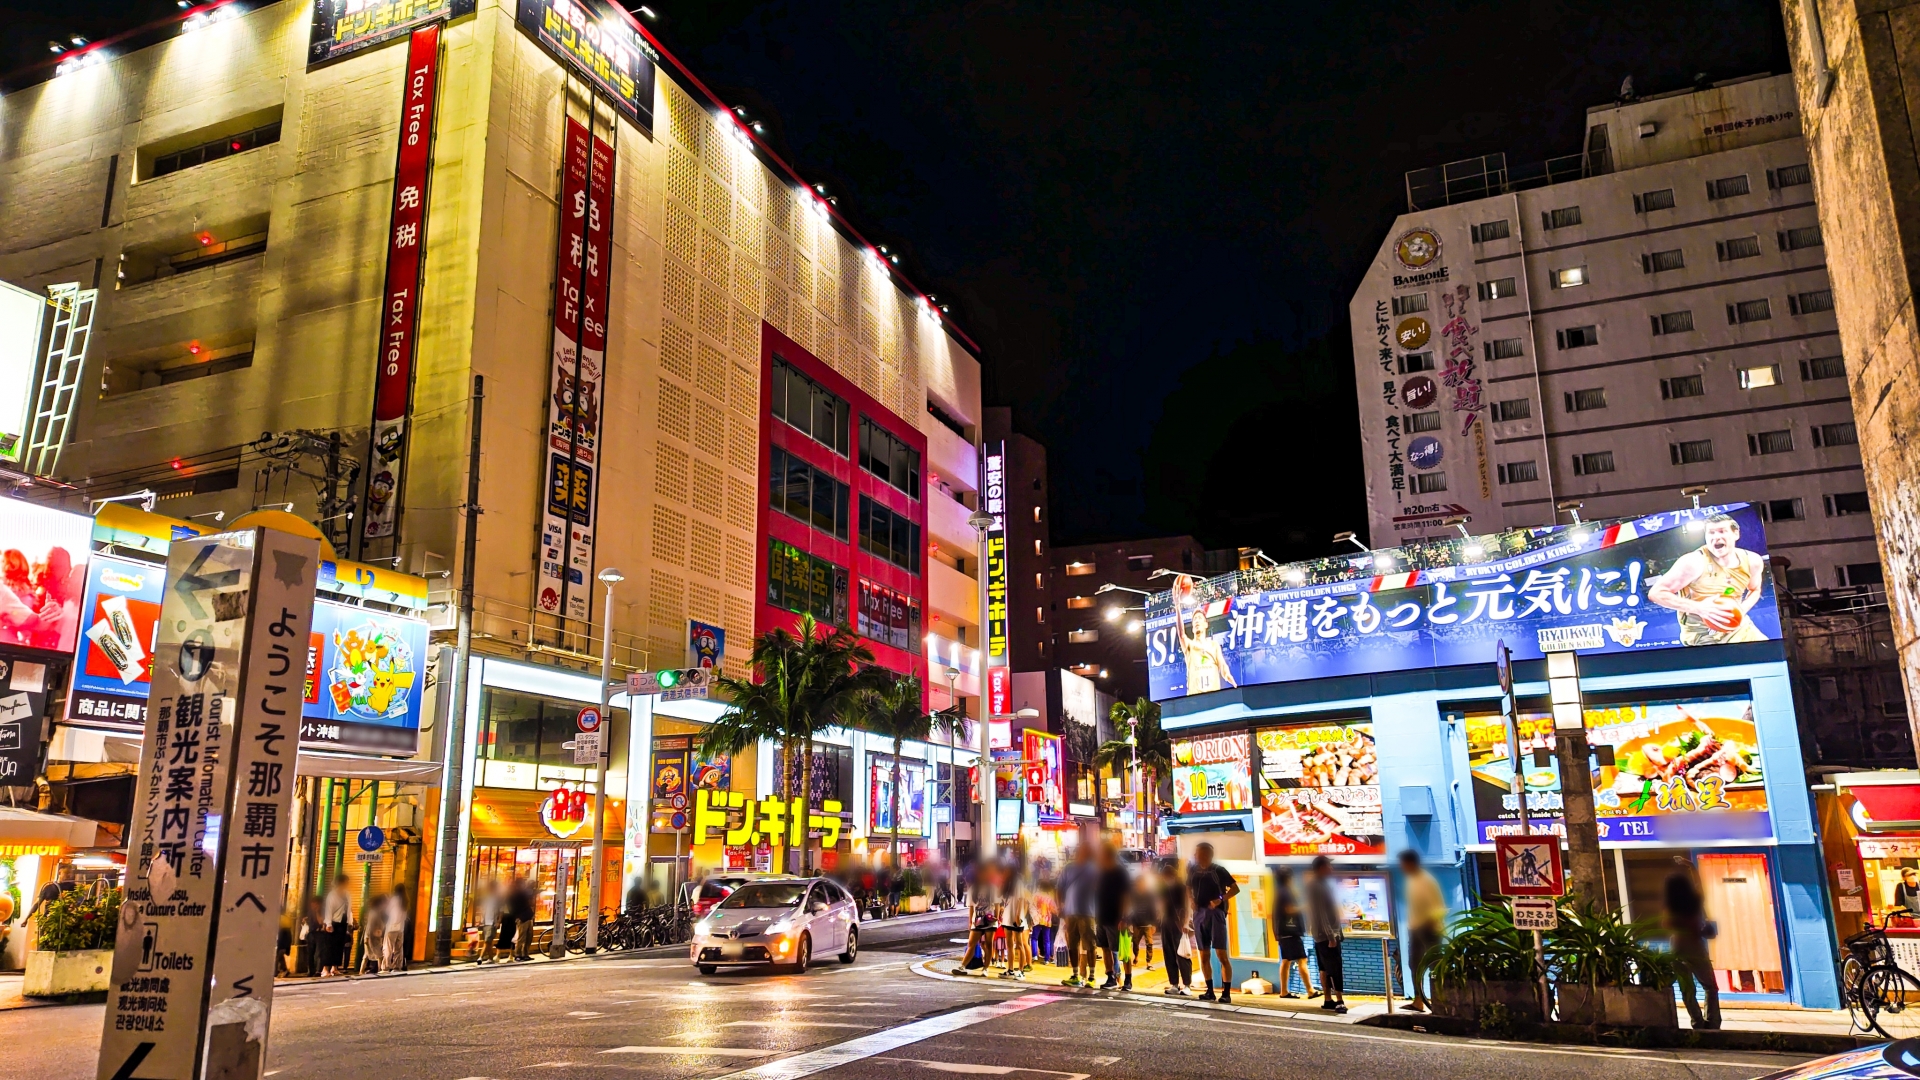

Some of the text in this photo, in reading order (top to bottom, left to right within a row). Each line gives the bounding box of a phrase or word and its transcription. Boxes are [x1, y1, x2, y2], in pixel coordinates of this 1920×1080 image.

[408, 65, 428, 147] Tax Free
[395, 185, 419, 249] 免税
[571, 190, 600, 278] 免税
[1393, 266, 1449, 286] BAMBOHE
[562, 277, 595, 313] Tax
[564, 301, 604, 338] Free
[387, 288, 408, 377] Tax Free
[554, 462, 589, 511] 薬
[987, 455, 1003, 532] 激安の殿堂
[548, 523, 562, 535] VISA
[1422, 519, 1443, 528] 11:00
[1505, 552, 1547, 571] GOLDEN
[771, 549, 828, 598] 医薬品
[835, 575, 847, 595] 4F
[1300, 587, 1331, 599] GOLDEN
[1332, 582, 1358, 595] KINGS
[863, 589, 903, 621] Tax Free
[910, 606, 919, 624] 4F
[1228, 560, 1642, 651] 沖縄をもっと元気に！
[1540, 625, 1602, 643] RYUKYU
[992, 672, 1003, 693] Tax
[661, 688, 707, 700] 時差式信号機
[1193, 735, 1247, 761] ORION
[235, 607, 297, 914] ようこそ那覇市へ
[507, 765, 516, 774] 35
[159, 692, 205, 879] 観光案内所
[189, 689, 228, 879] Tourist Information Center
[1190, 771, 1226, 800] 10m先
[1619, 821, 1654, 836] TEL
[127, 888, 150, 901] Inside
[177, 903, 207, 917] Center
[1516, 910, 1555, 919] わたるな
[155, 951, 194, 971] Toilets
[115, 1014, 165, 1032] 관광안내소
